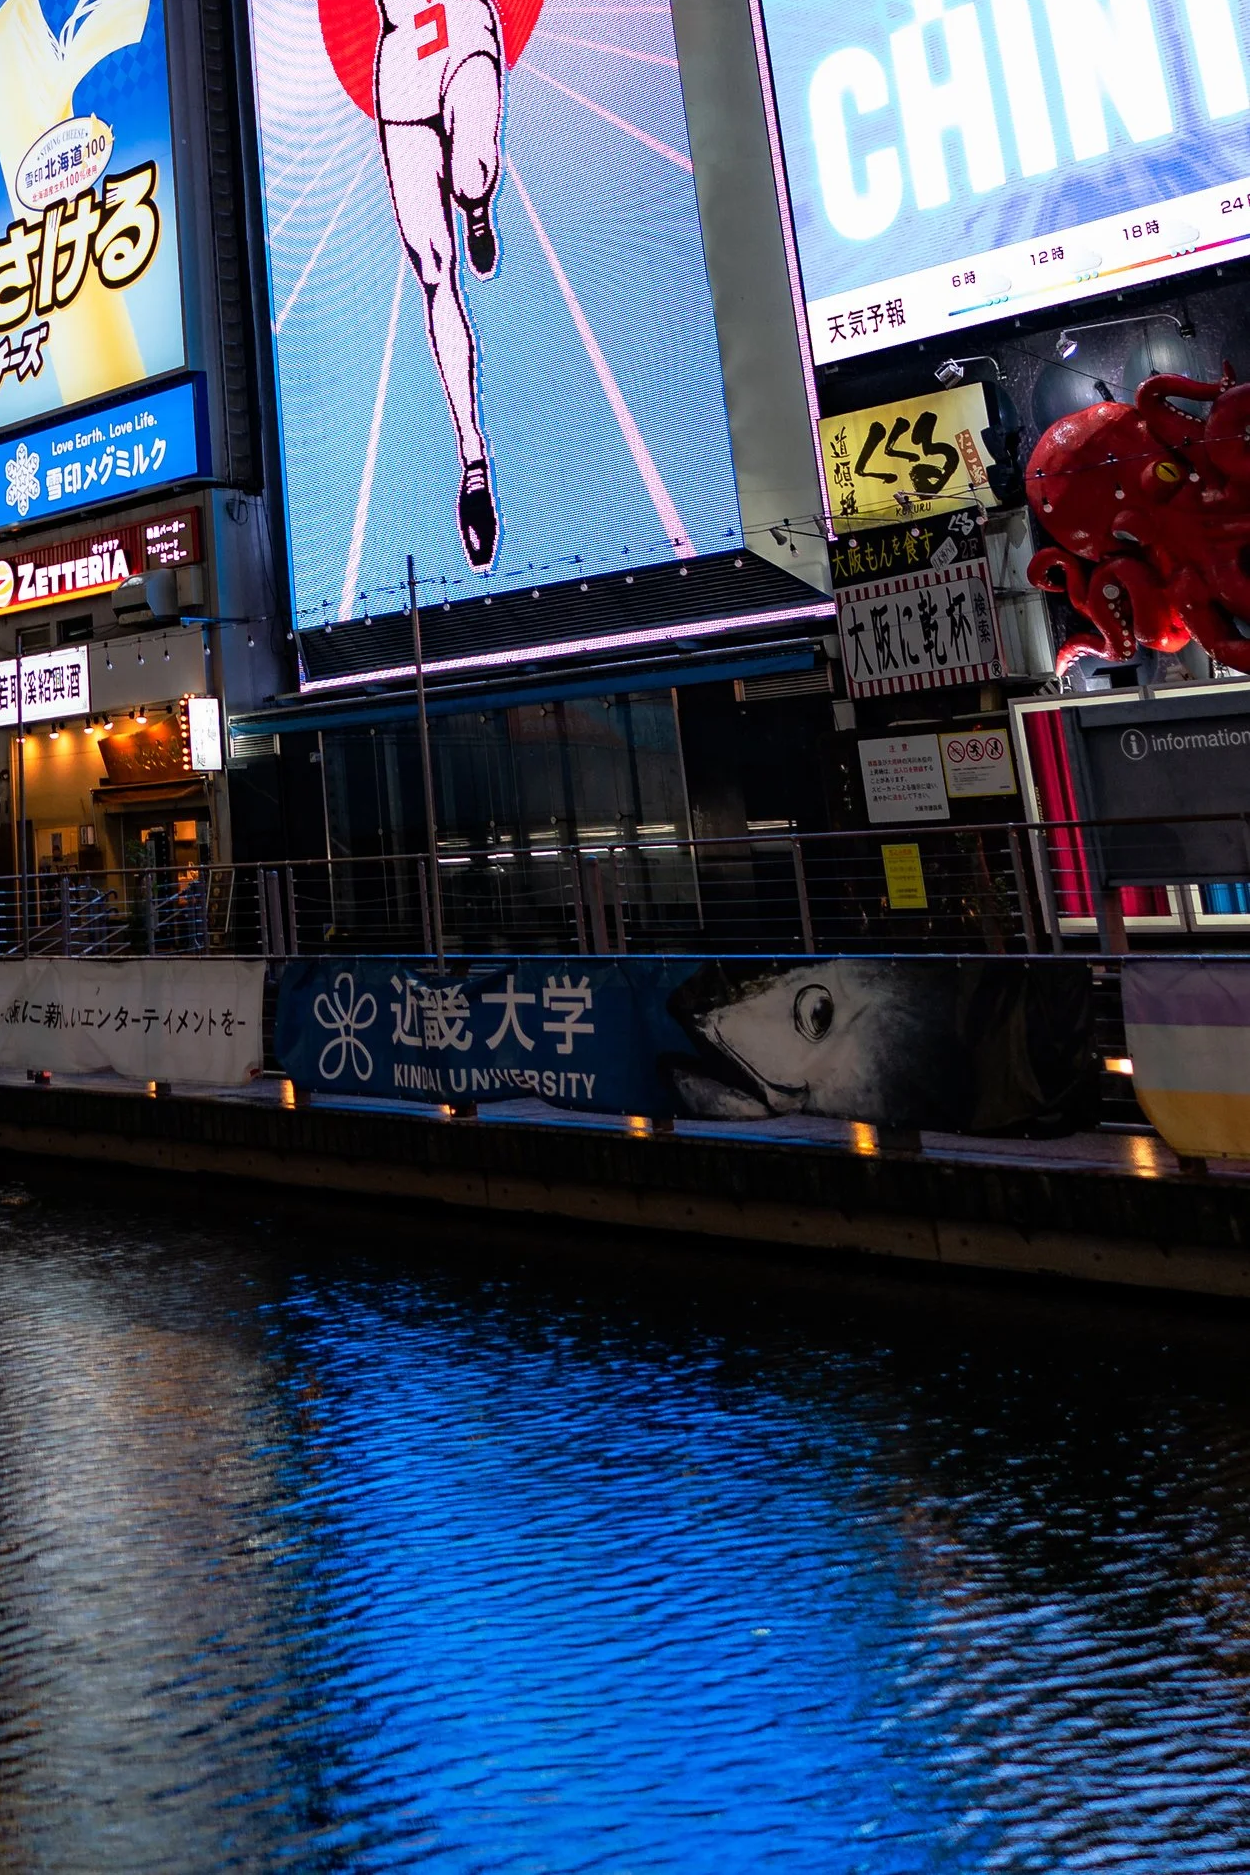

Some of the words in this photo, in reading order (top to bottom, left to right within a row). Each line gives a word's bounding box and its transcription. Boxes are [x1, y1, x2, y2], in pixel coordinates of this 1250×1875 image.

[1121, 220, 1161, 241] 18時
[951, 270, 977, 288] 6時
[1028, 246, 1065, 267] 12時
[827, 298, 906, 344] 天気予報
[51, 437, 72, 456] Love
[74, 429, 106, 451] Earth.
[109, 420, 132, 440] Love
[135, 411, 157, 432] Life.
[854, 411, 960, 501] くくる
[45, 435, 167, 504] 雪印メグミルク
[830, 426, 859, 517] 道頓堀
[160, 549, 188, 564] コーヒー
[959, 537, 979, 560] 2F
[17, 549, 130, 602] ZETTERIA
[847, 586, 973, 679] 大阪に乾杯
[390, 973, 595, 1055] 近畿大学
[393, 1062, 443, 1093] KINDAI
[448, 1068, 597, 1100] UNIVERSITY
